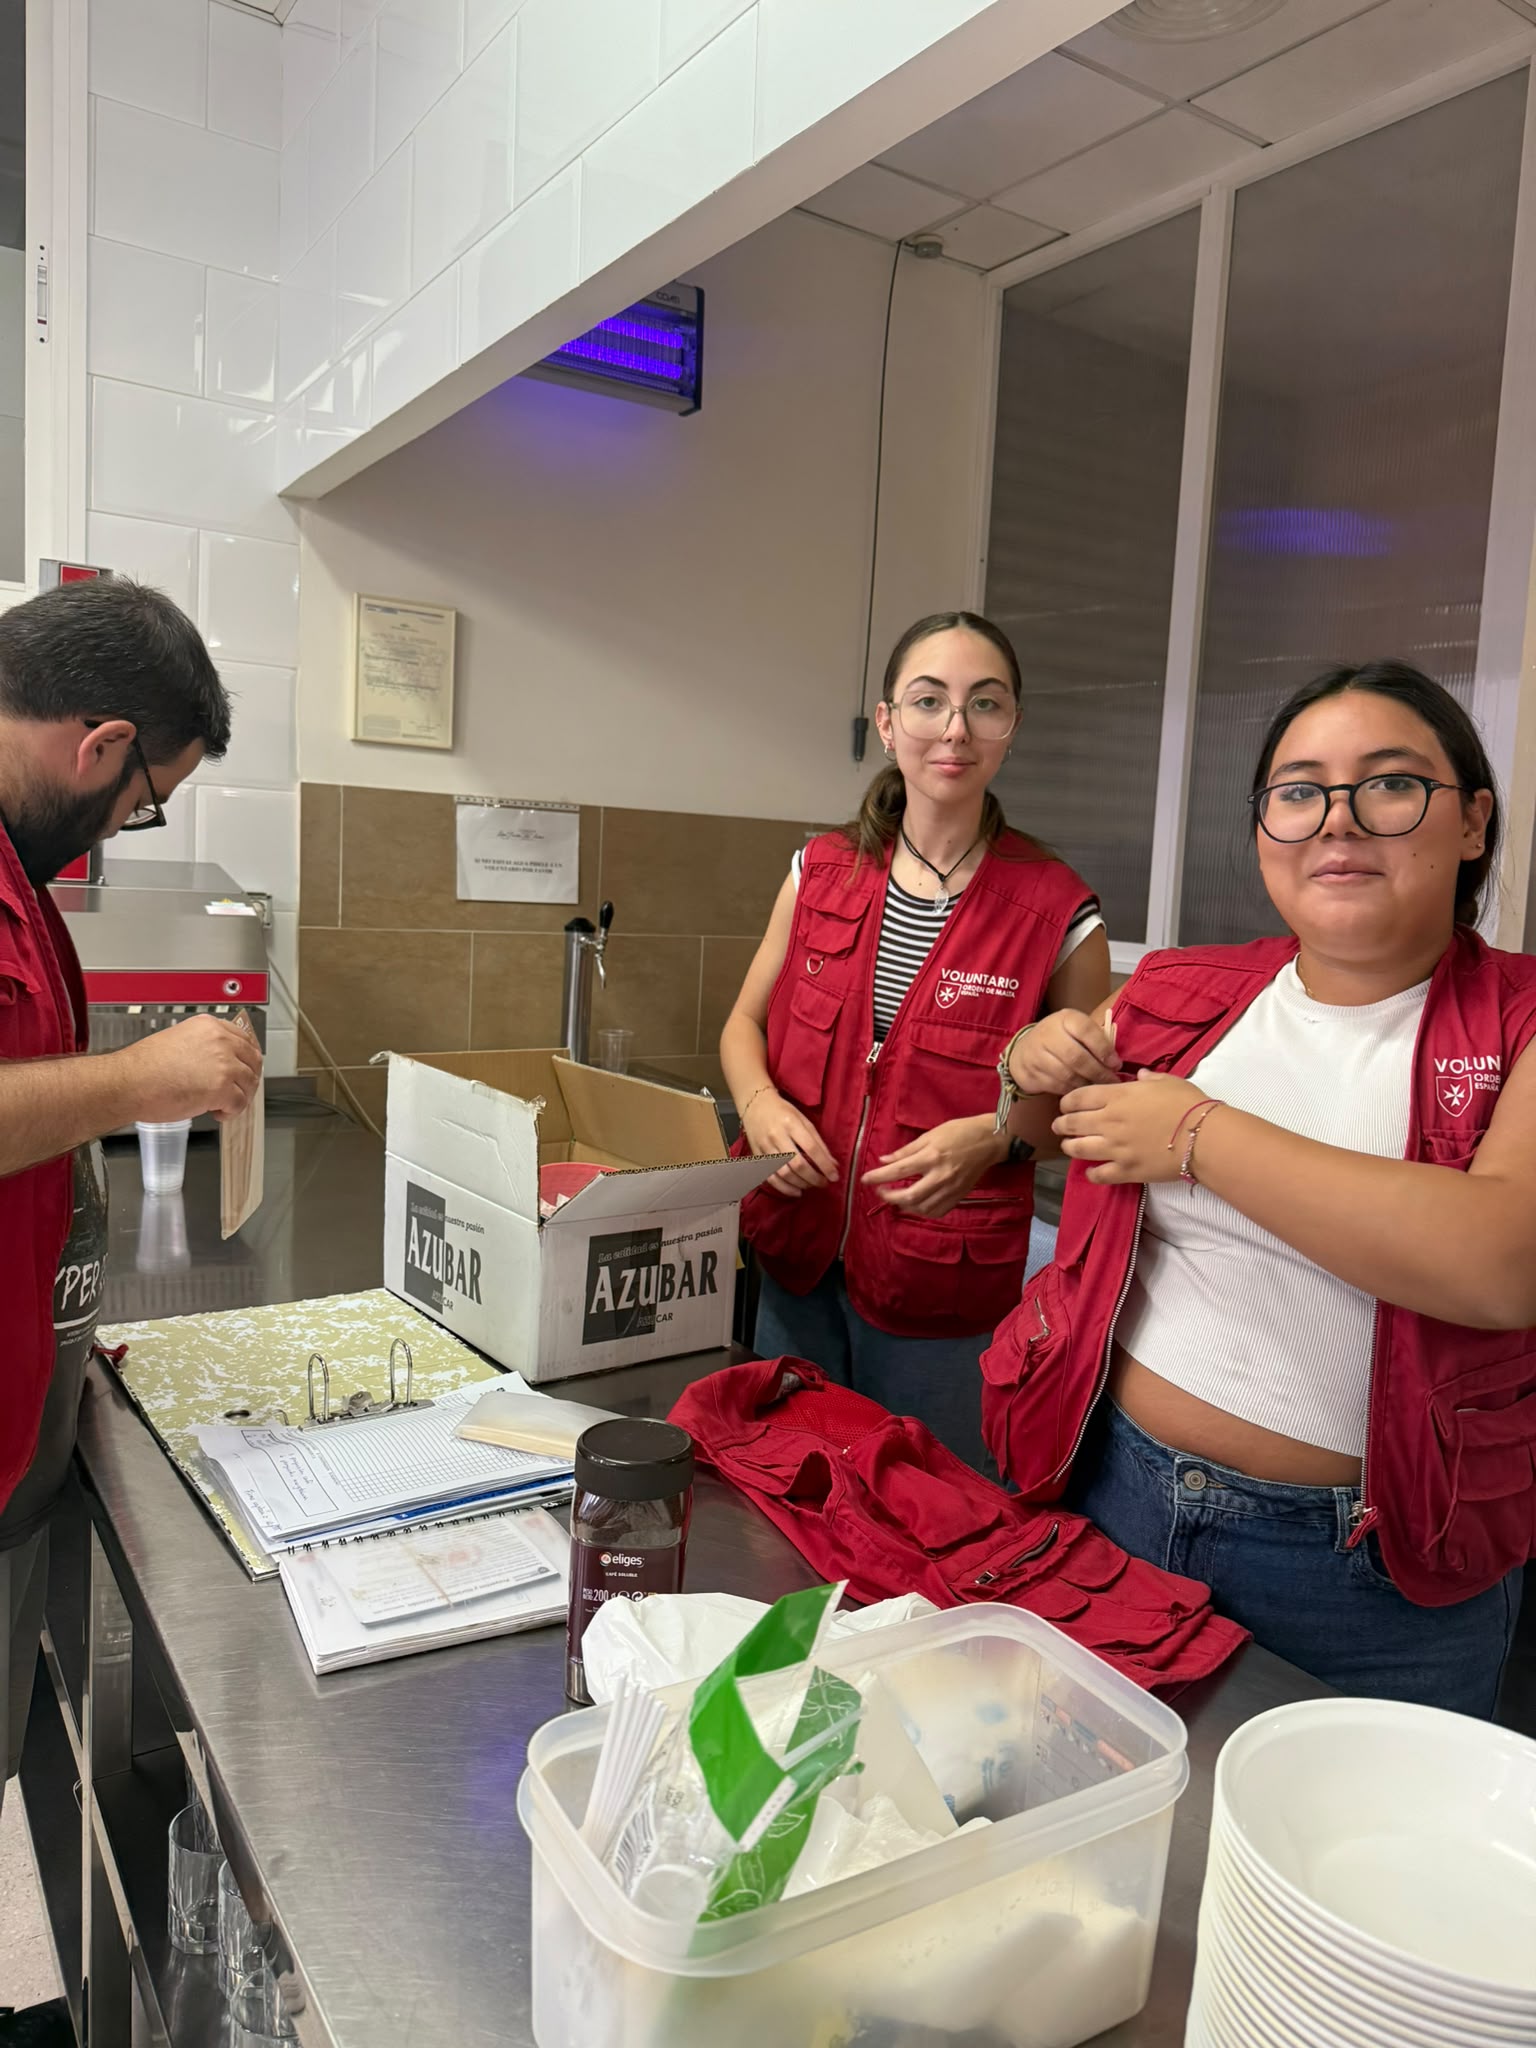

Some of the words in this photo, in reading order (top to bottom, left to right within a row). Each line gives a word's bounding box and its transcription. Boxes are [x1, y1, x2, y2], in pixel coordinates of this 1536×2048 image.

[941, 967, 1019, 990] VOLUNTARIO
[962, 984, 985, 993] ORDEN
[995, 989, 1016, 998] MALTA
[444, 1215, 465, 1228] nuestra
[466, 1222, 485, 1234] pasión
[660, 1232, 694, 1248] nuestra
[694, 1226, 723, 1241] pasión
[407, 1215, 482, 1305] AZUBAR
[589, 1250, 718, 1315] AZUBAR
[612, 1553, 643, 1567] eliges
[593, 1589, 609, 1601] 200
